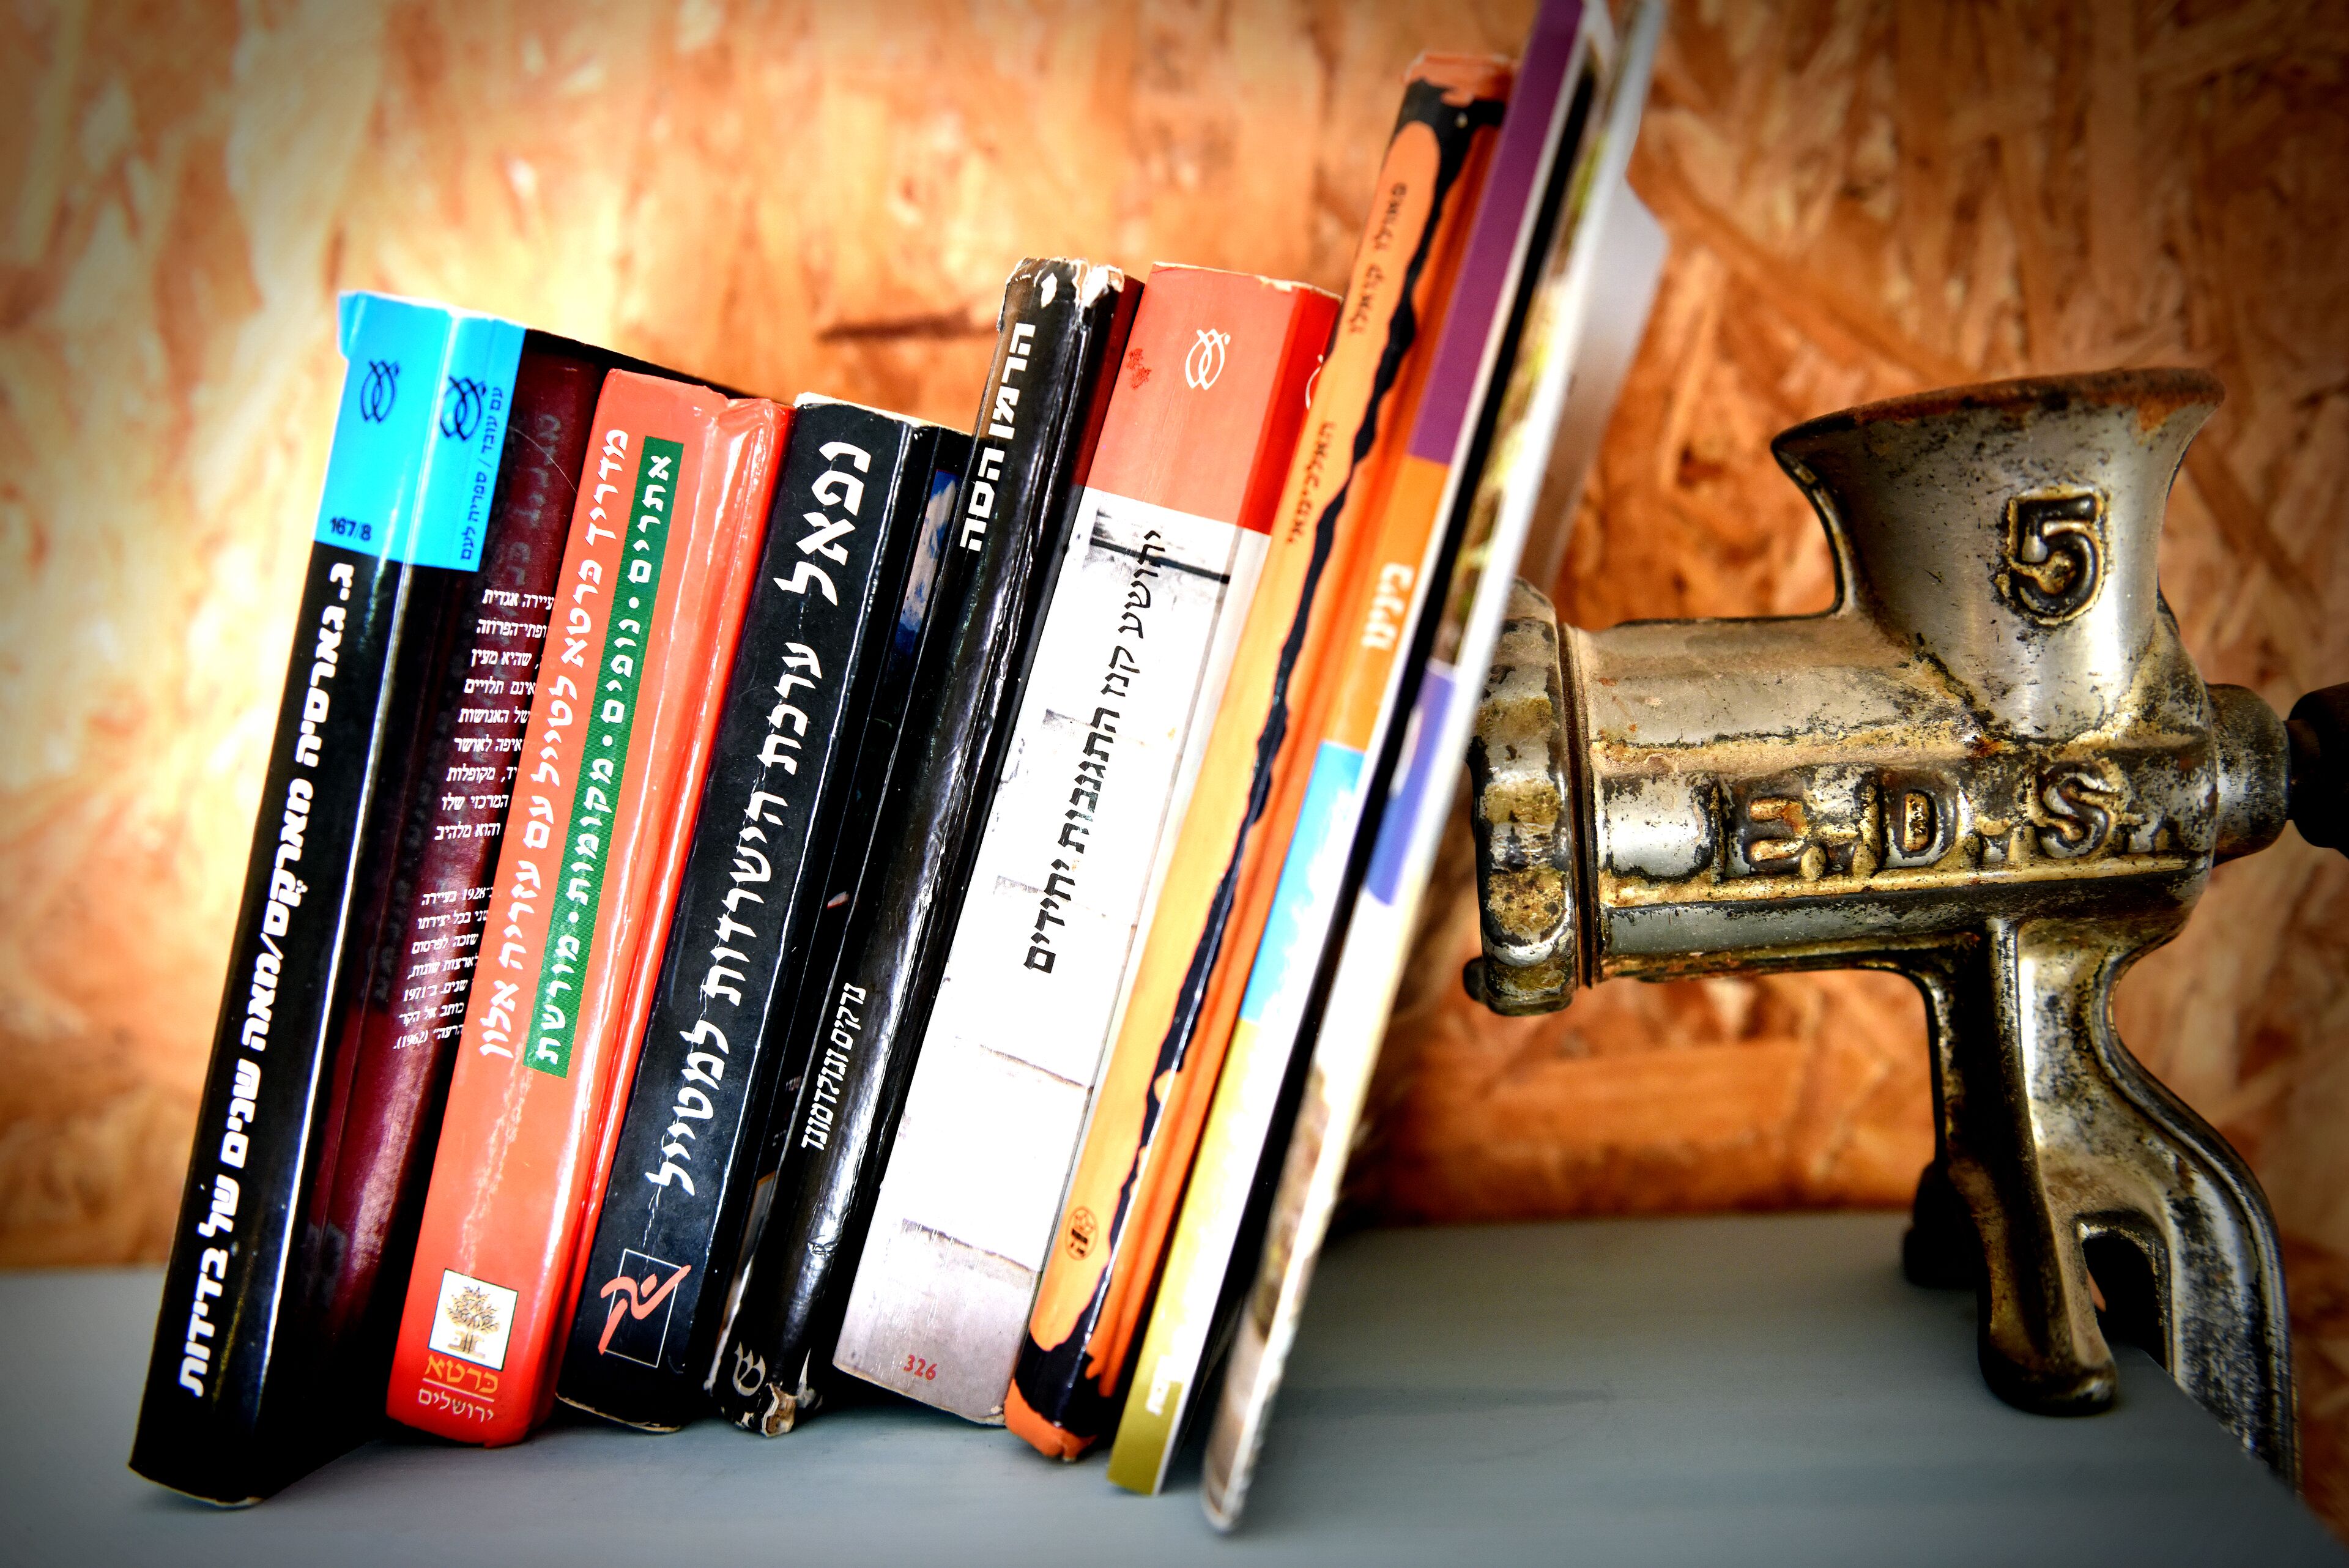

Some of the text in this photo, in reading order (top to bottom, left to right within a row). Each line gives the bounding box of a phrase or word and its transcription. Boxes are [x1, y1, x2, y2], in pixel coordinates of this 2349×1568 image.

[1348, 182, 1407, 334] פאולו קואלו
[490, 387, 505, 411] עם
[481, 416, 497, 455] עובד
[960, 323, 1035, 551] הרמן הסה
[468, 471, 487, 522] ספריה
[586, 429, 628, 546] מדריך
[1288, 421, 1335, 544] האלכימאי
[330, 517, 371, 541] 167/8
[460, 526, 477, 561] לעם
[2009, 489, 2104, 624] 5
[330, 563, 354, 600] ג.
[482, 589, 519, 606] אגדית
[471, 649, 498, 667] מעין
[501, 652, 532, 666] שהיא
[295, 605, 346, 768] גארסיה
[464, 676, 504, 694] תלויים
[458, 706, 530, 723] של האנושות
[530, 675, 577, 786] לטייל
[454, 734, 492, 752] לאושר
[535, 455, 672, 1065] אתרים נופים מקומות מורשת
[1023, 530, 1165, 973] יהושע קנז התגנבות יחידים
[447, 764, 495, 783] מקופלות
[442, 792, 509, 811] המרכזי שלו
[645, 442, 870, 1195] נפאל ערכת הישרדות למטייל
[434, 821, 500, 841] והוא מלהיב
[522, 795, 554, 849] עם
[421, 891, 457, 905] בעיירה
[498, 860, 541, 970] עזריה
[418, 915, 450, 929] יצירתו
[453, 910, 471, 924] בכל
[412, 934, 478, 954] שזכה לפרסום
[440, 980, 468, 994] שנים.
[425, 1006, 437, 1019] אל
[440, 1002, 464, 1017] כותב
[479, 980, 519, 1059] אלון
[220, 1058, 261, 1169] שנים
[801, 1048, 849, 1150] וגולדמונד
[197, 1175, 239, 1239] של
[178, 1247, 228, 1397] בדידות
[903, 1354, 938, 1381] 326
[418, 1388, 494, 1422] ירושלים
